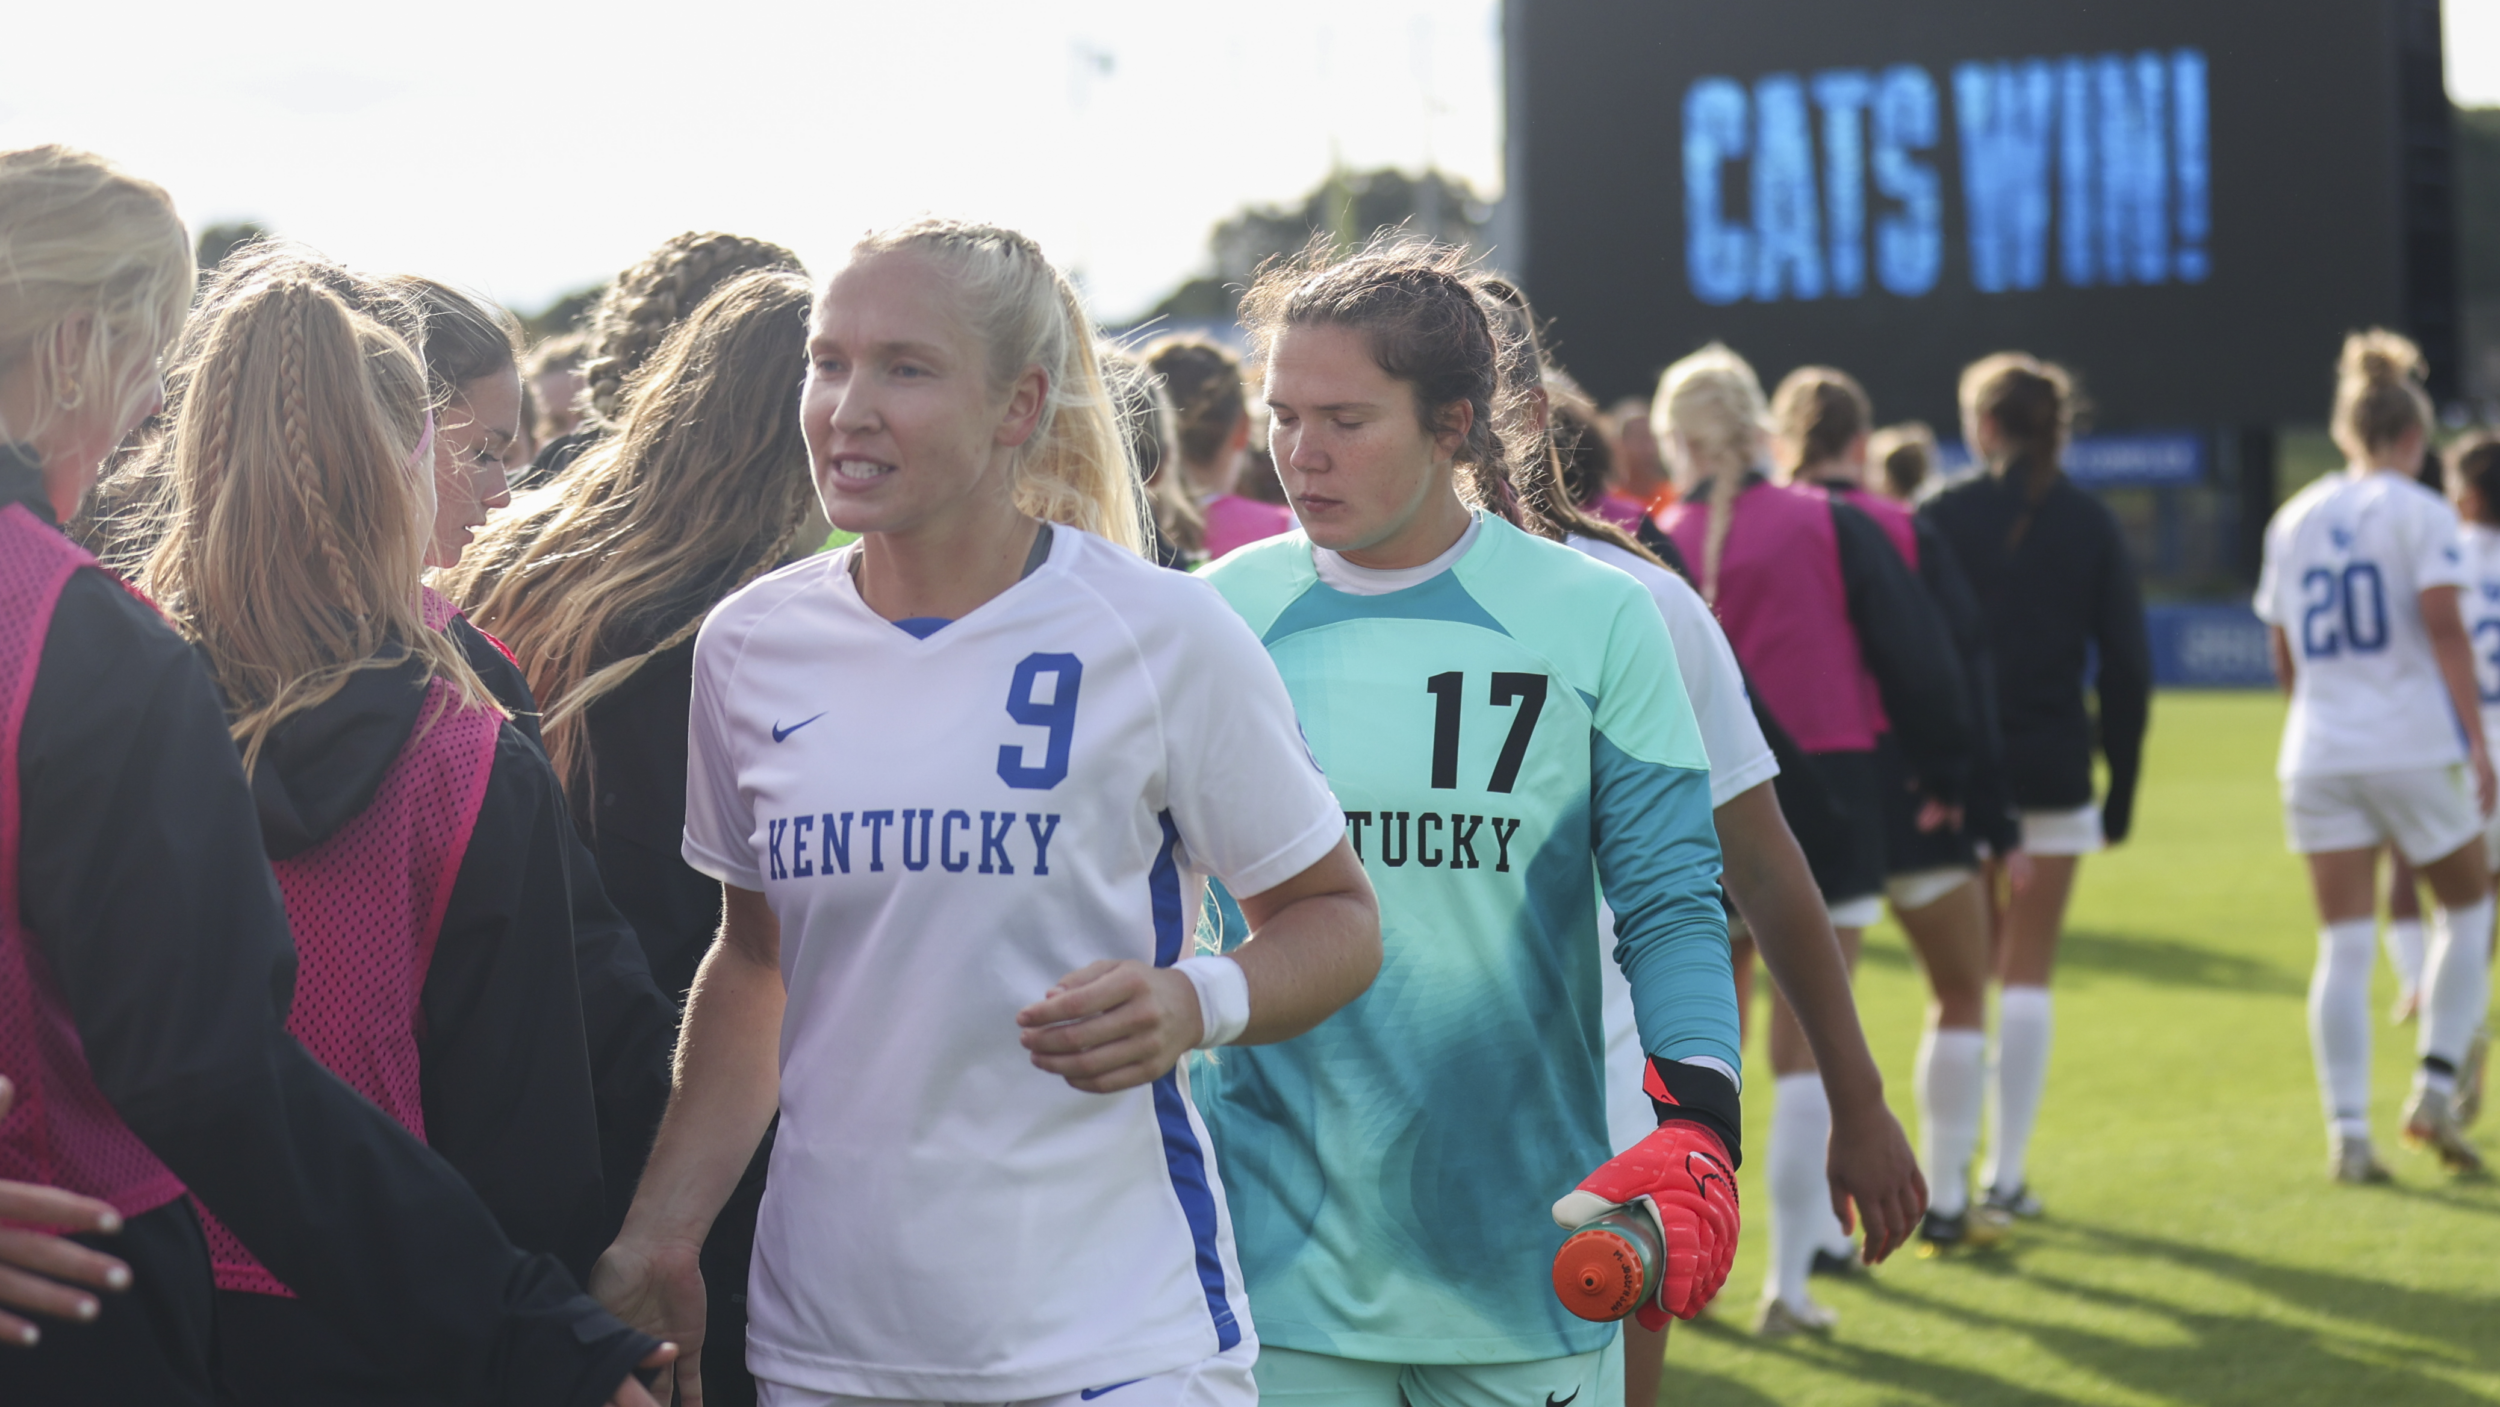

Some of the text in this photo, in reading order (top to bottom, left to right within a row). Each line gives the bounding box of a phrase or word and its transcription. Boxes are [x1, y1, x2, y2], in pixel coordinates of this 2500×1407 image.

[1683, 48, 2211, 304] CATS WIN!
[2302, 561, 2388, 658] 20
[996, 651, 1084, 790] 9
[1427, 671, 1549, 794] 17
[767, 808, 1062, 881] KENTUCKY
[1344, 811, 1521, 873] TUCKY
